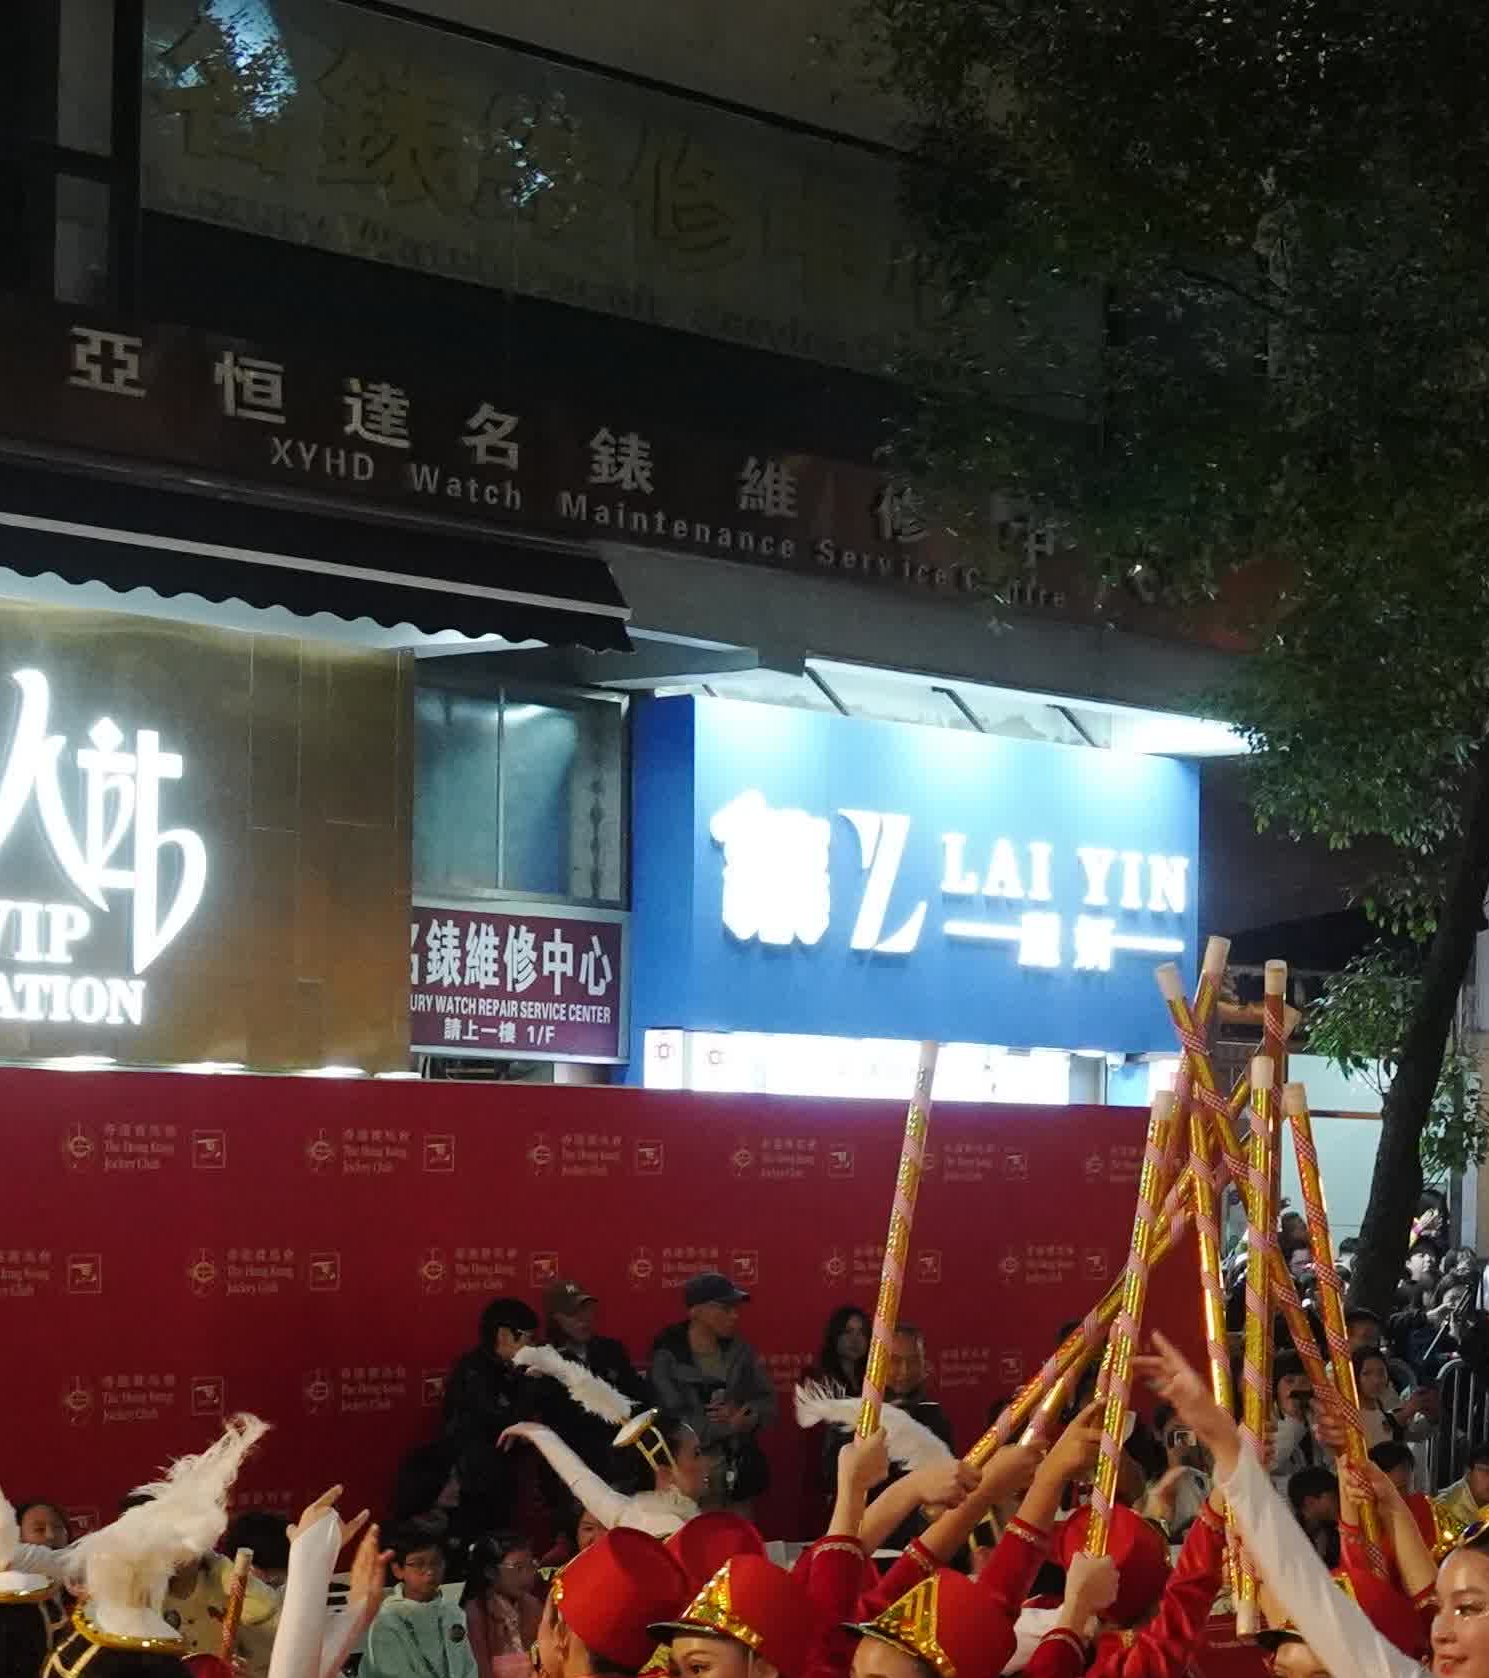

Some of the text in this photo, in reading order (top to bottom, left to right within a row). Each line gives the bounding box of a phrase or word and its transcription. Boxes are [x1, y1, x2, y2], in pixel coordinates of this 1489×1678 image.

[270, 436, 376, 483] XYHD
[409, 462, 523, 512] Watch
[559, 491, 797, 560] Maintenance
[815, 536, 949, 590] Service
[940, 832, 1191, 914] LAI YIN
[435, 995, 478, 1016] WATCH
[478, 998, 519, 1018] REPAIR
[519, 1001, 567, 1022] SERVICE
[568, 1004, 611, 1024] CENTER
[443, 1017, 516, 1044] 請上一樓
[526, 1024, 556, 1046] 1/F
